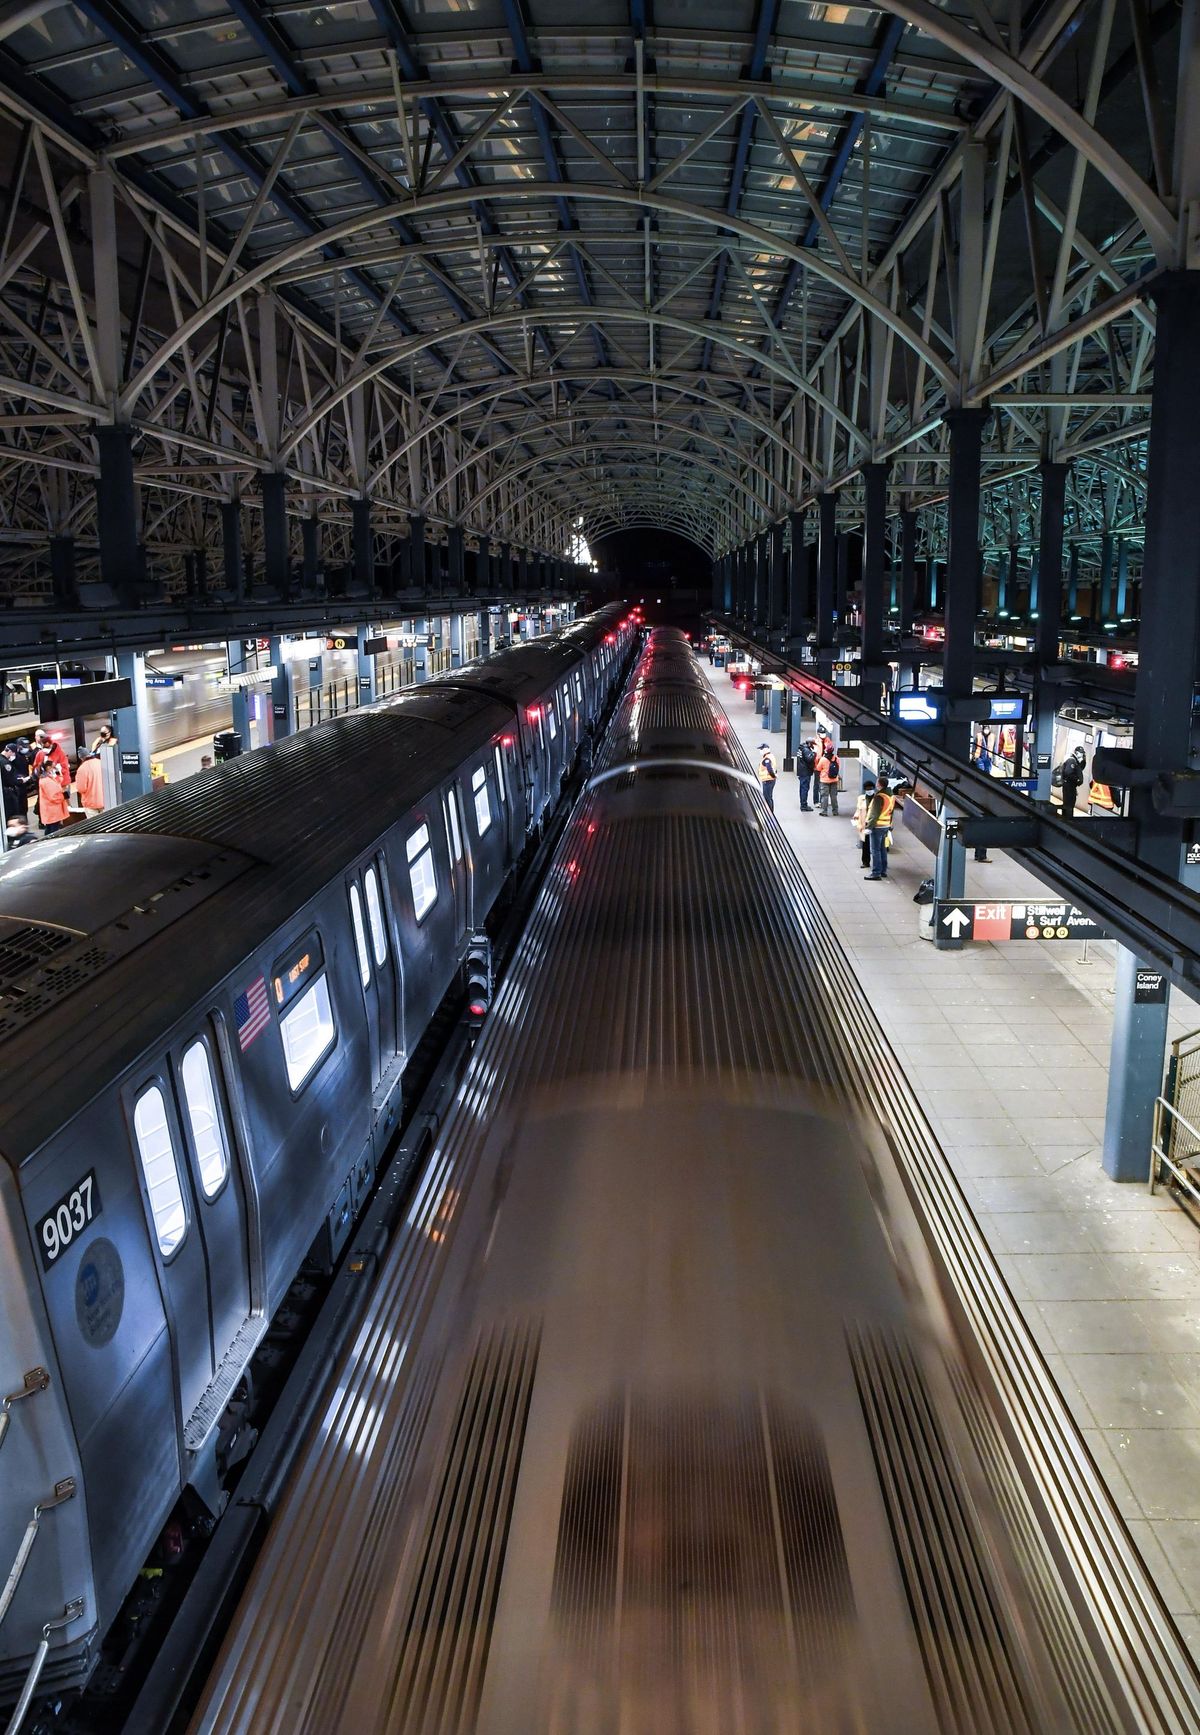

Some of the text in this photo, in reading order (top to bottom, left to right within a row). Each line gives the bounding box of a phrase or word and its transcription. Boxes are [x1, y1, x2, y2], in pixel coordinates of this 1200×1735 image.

[1010, 780, 1027, 788] Area
[974, 905, 1006, 921] Exit
[1027, 904, 1066, 916] Stillwell
[1026, 916, 1036, 926] &
[1039, 916, 1063, 926] Surf
[1137, 973, 1163, 983] Coney
[1136, 981, 1160, 990] Island
[42, 1175, 93, 1260] 9037
